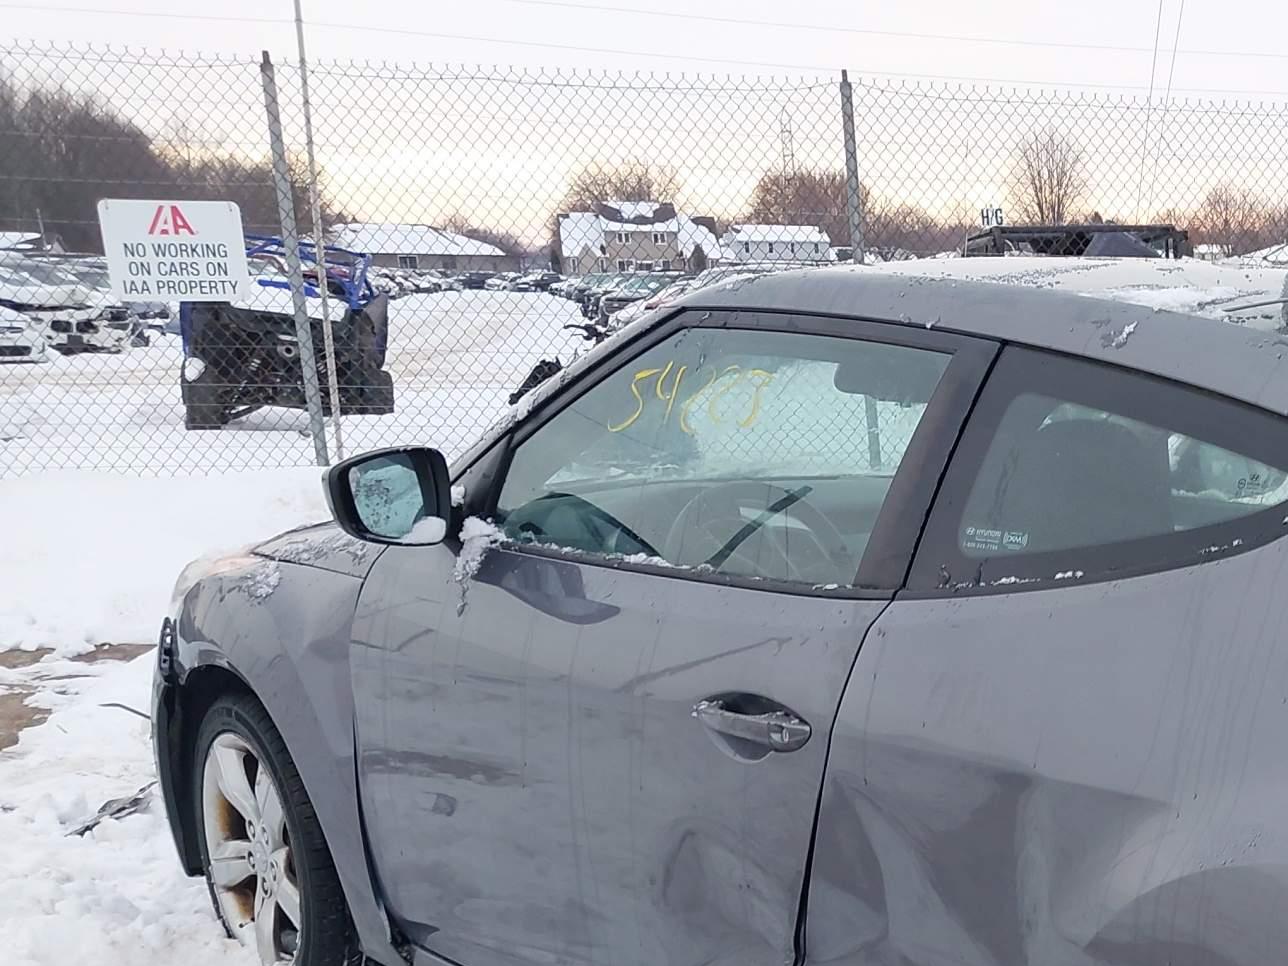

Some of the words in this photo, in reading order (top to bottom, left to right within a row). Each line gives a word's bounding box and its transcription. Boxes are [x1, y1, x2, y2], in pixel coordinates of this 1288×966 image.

[122, 242, 147, 258] NO
[151, 243, 228, 258] WORKING
[128, 261, 152, 277] ON
[157, 261, 201, 277] CARS
[206, 262, 229, 277] ON
[122, 279, 152, 295] IAA
[156, 280, 239, 295] PROPERTY
